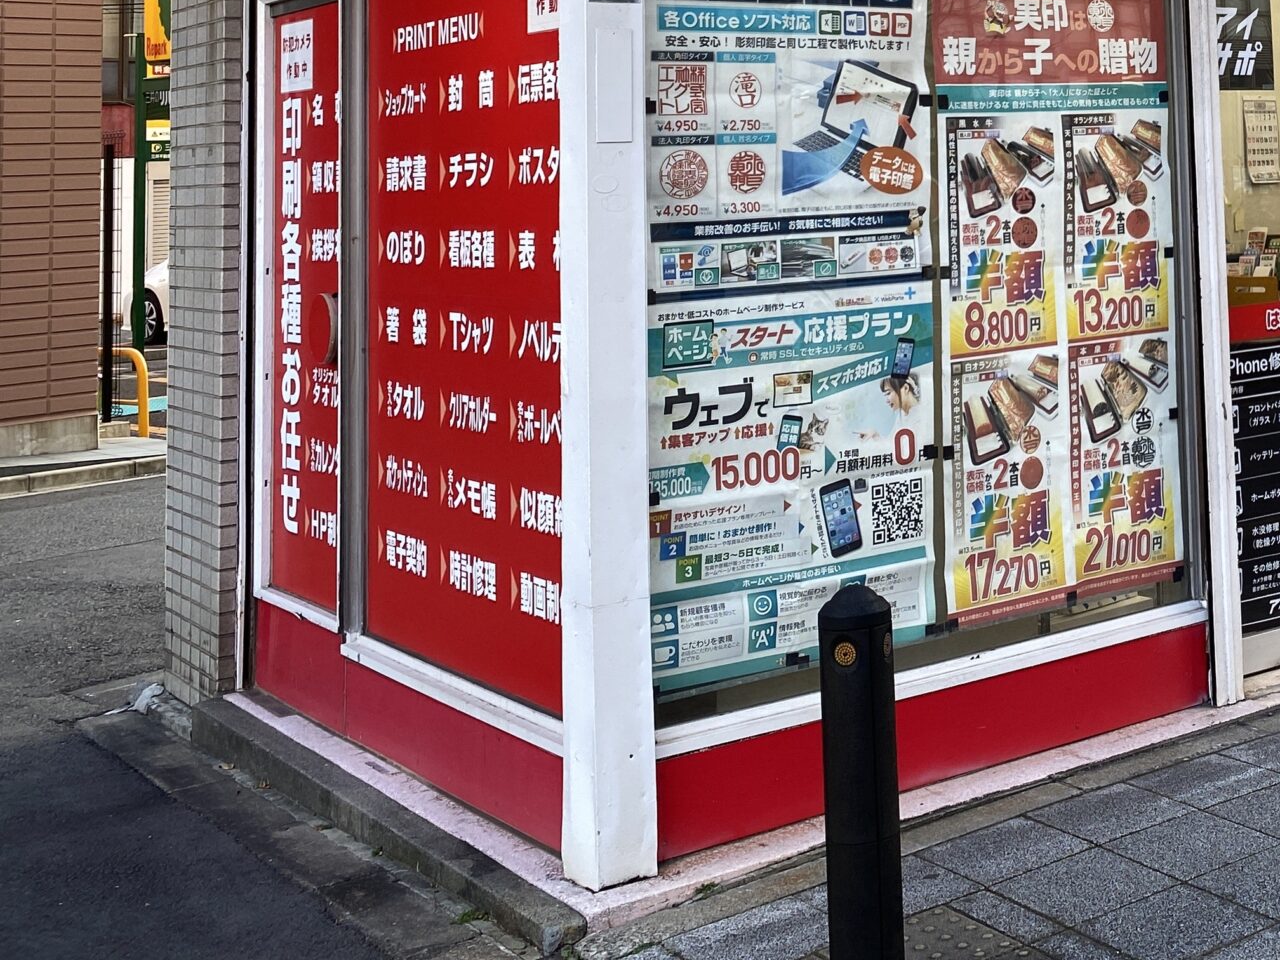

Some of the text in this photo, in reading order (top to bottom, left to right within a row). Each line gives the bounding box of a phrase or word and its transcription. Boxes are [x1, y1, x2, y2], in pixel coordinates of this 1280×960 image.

[147, 37, 166, 57] Repark
[282, 28, 311, 53] 防犯カメラ
[398, 14, 479, 53] PRINT MENU
[943, 35, 1158, 76] 親から子への贈物
[385, 83, 427, 117] ショップカード
[448, 71, 494, 112] 封筒
[518, 62, 560, 103] 伝票各
[658, 120, 698, 131] ¥4,950
[723, 120, 760, 131] ¥2,750
[386, 155, 426, 192] 請求書
[449, 153, 494, 187] チラシ
[869, 166, 914, 190] 電子印鑑
[872, 151, 915, 173] データには
[656, 204, 698, 217] ¥4,950
[724, 201, 760, 214] ¥3,300
[387, 230, 425, 265] のぼり
[449, 230, 495, 269] 看板各種
[1082, 239, 1160, 292] 半額
[966, 248, 1045, 306] 半額
[280, 97, 303, 536] 印刷各種お任せ
[450, 312, 494, 355] Tシャツ
[668, 326, 708, 343] ホーム
[730, 312, 913, 349] スタート 応援プラン
[667, 343, 710, 361] ページ
[393, 382, 425, 422] タオル
[450, 392, 496, 434] クリアホルダー
[663, 376, 769, 430] ウェブで
[668, 424, 767, 449] 集客アップ 応援
[454, 480, 496, 520] メモ帳
[1088, 468, 1165, 526] 半額
[654, 522, 661, 533] 1
[969, 490, 1052, 552] 半額
[386, 531, 427, 578] 電子契約
[663, 535, 683, 544] POINT
[669, 544, 677, 556] 2
[450, 550, 496, 602] 時計修理
[679, 557, 699, 566] POINT
[685, 566, 693, 578] 3
